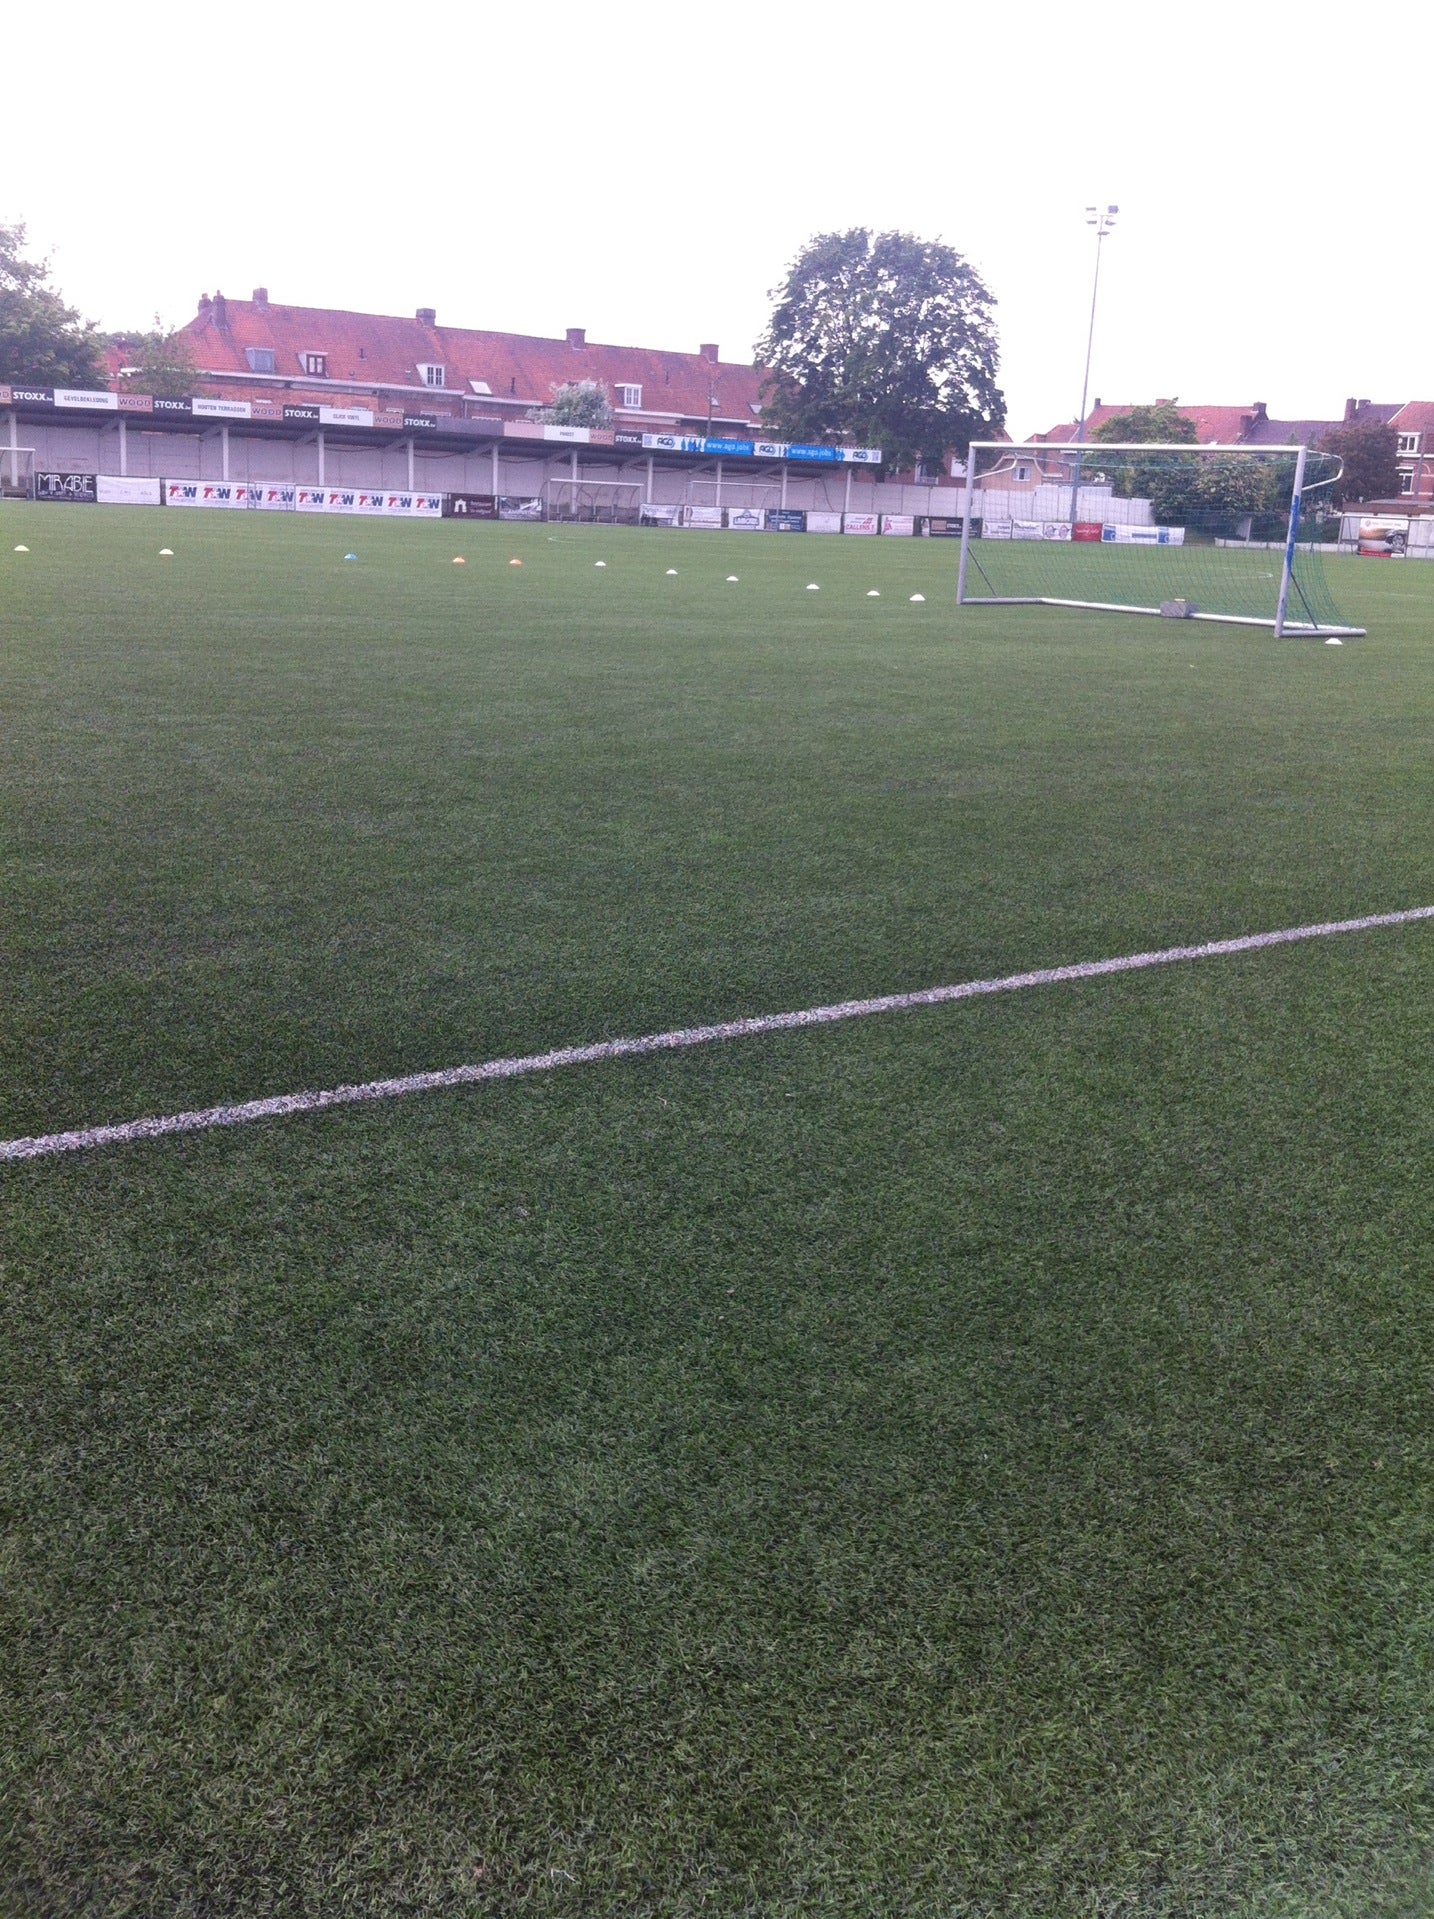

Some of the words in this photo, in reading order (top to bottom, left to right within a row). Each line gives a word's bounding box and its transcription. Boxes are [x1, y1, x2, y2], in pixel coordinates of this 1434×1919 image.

[119, 398, 151, 407] WOOD
[252, 407, 282, 416] WOOD
[374, 416, 402, 425] WOOD
[591, 433, 613, 441] WOOD
